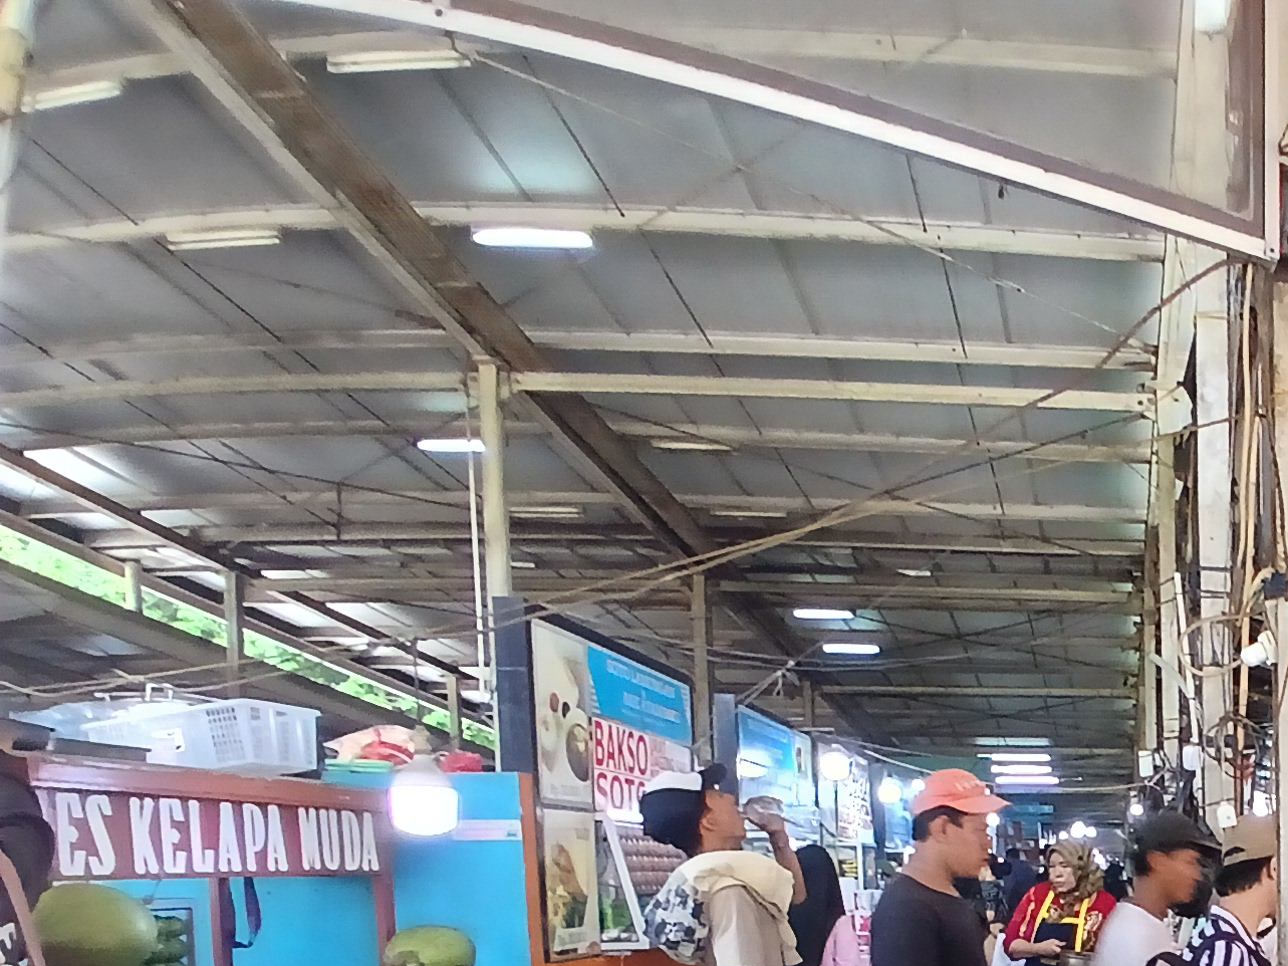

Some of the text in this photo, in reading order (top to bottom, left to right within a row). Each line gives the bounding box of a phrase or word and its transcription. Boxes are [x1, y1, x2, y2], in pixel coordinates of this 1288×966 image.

[594, 719, 649, 776] BAKSO
[54, 792, 380, 876] ES KELAPA MUDA
